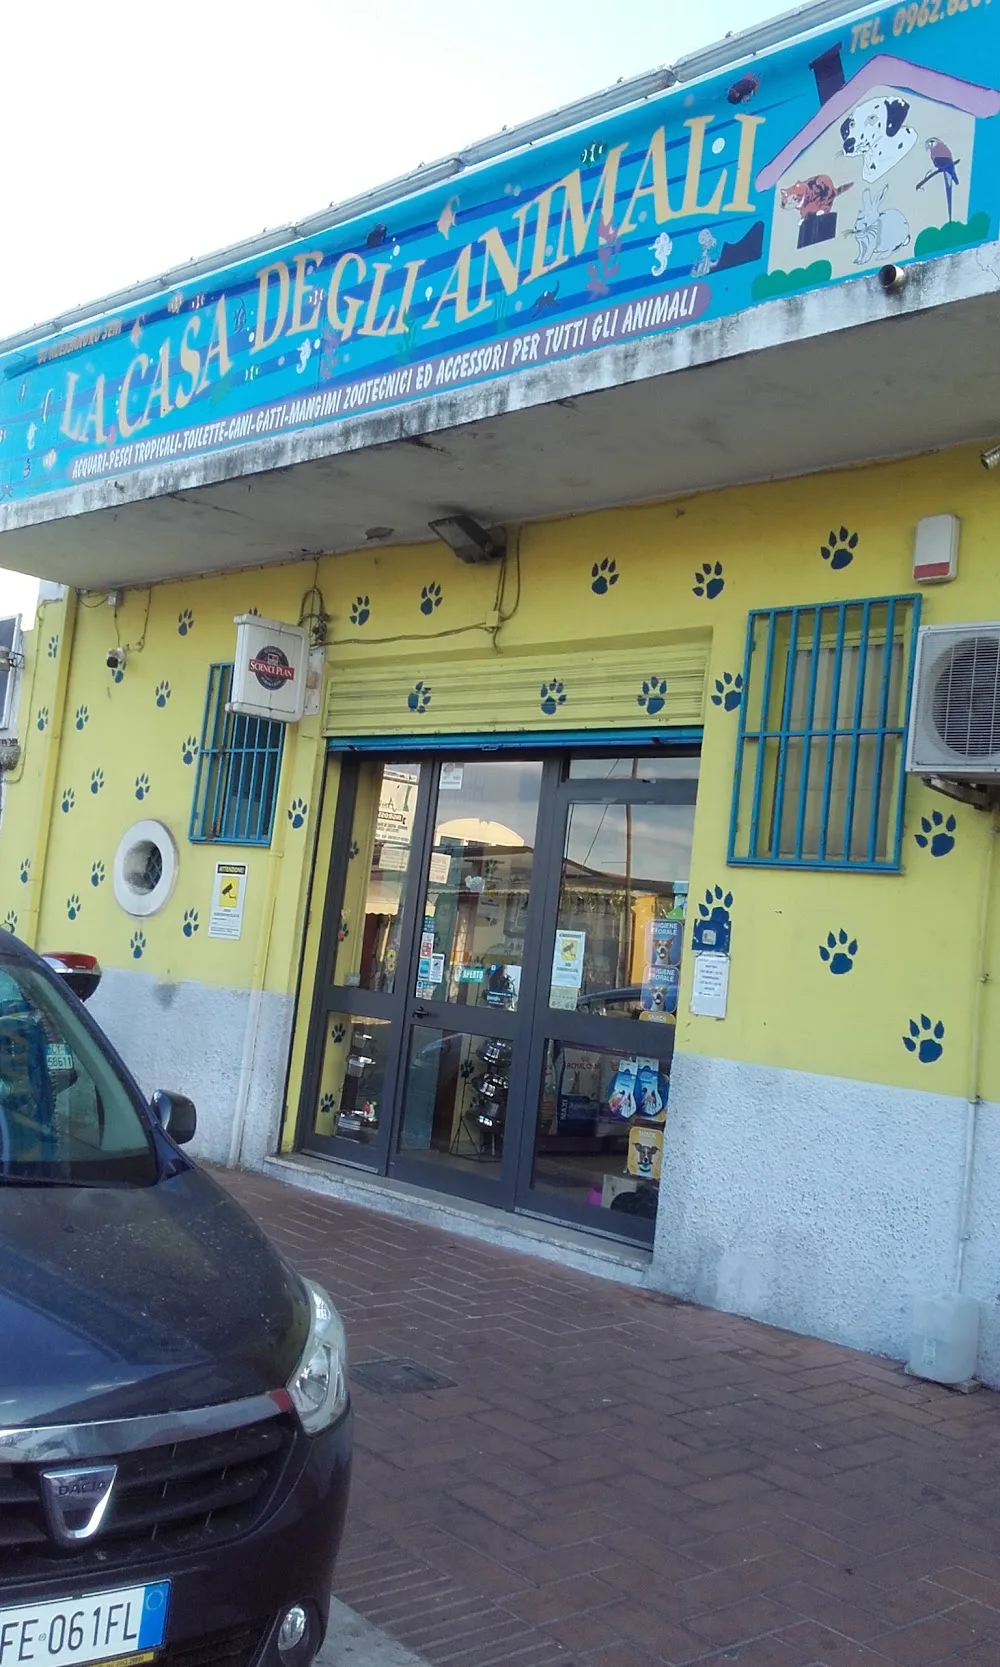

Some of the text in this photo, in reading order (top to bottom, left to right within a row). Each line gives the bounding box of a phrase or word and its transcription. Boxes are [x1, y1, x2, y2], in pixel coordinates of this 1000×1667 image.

[851, 16, 885, 54] TEL.
[61, 113, 766, 444] LA CASA DEGLI ANIMALI
[343, 368, 413, 411] ZOOTECNICI
[415, 363, 433, 390] ED
[436, 341, 508, 386] ACCESSORI
[511, 332, 541, 365] PER
[544, 317, 588, 357] TUTTI
[591, 308, 619, 342] GLI
[621, 286, 698, 334] ANIMALI
[462, 969, 484, 979] APERTO
[58, 1481, 106, 1496] DACIA
[47, 1601, 138, 1655] 061FL
